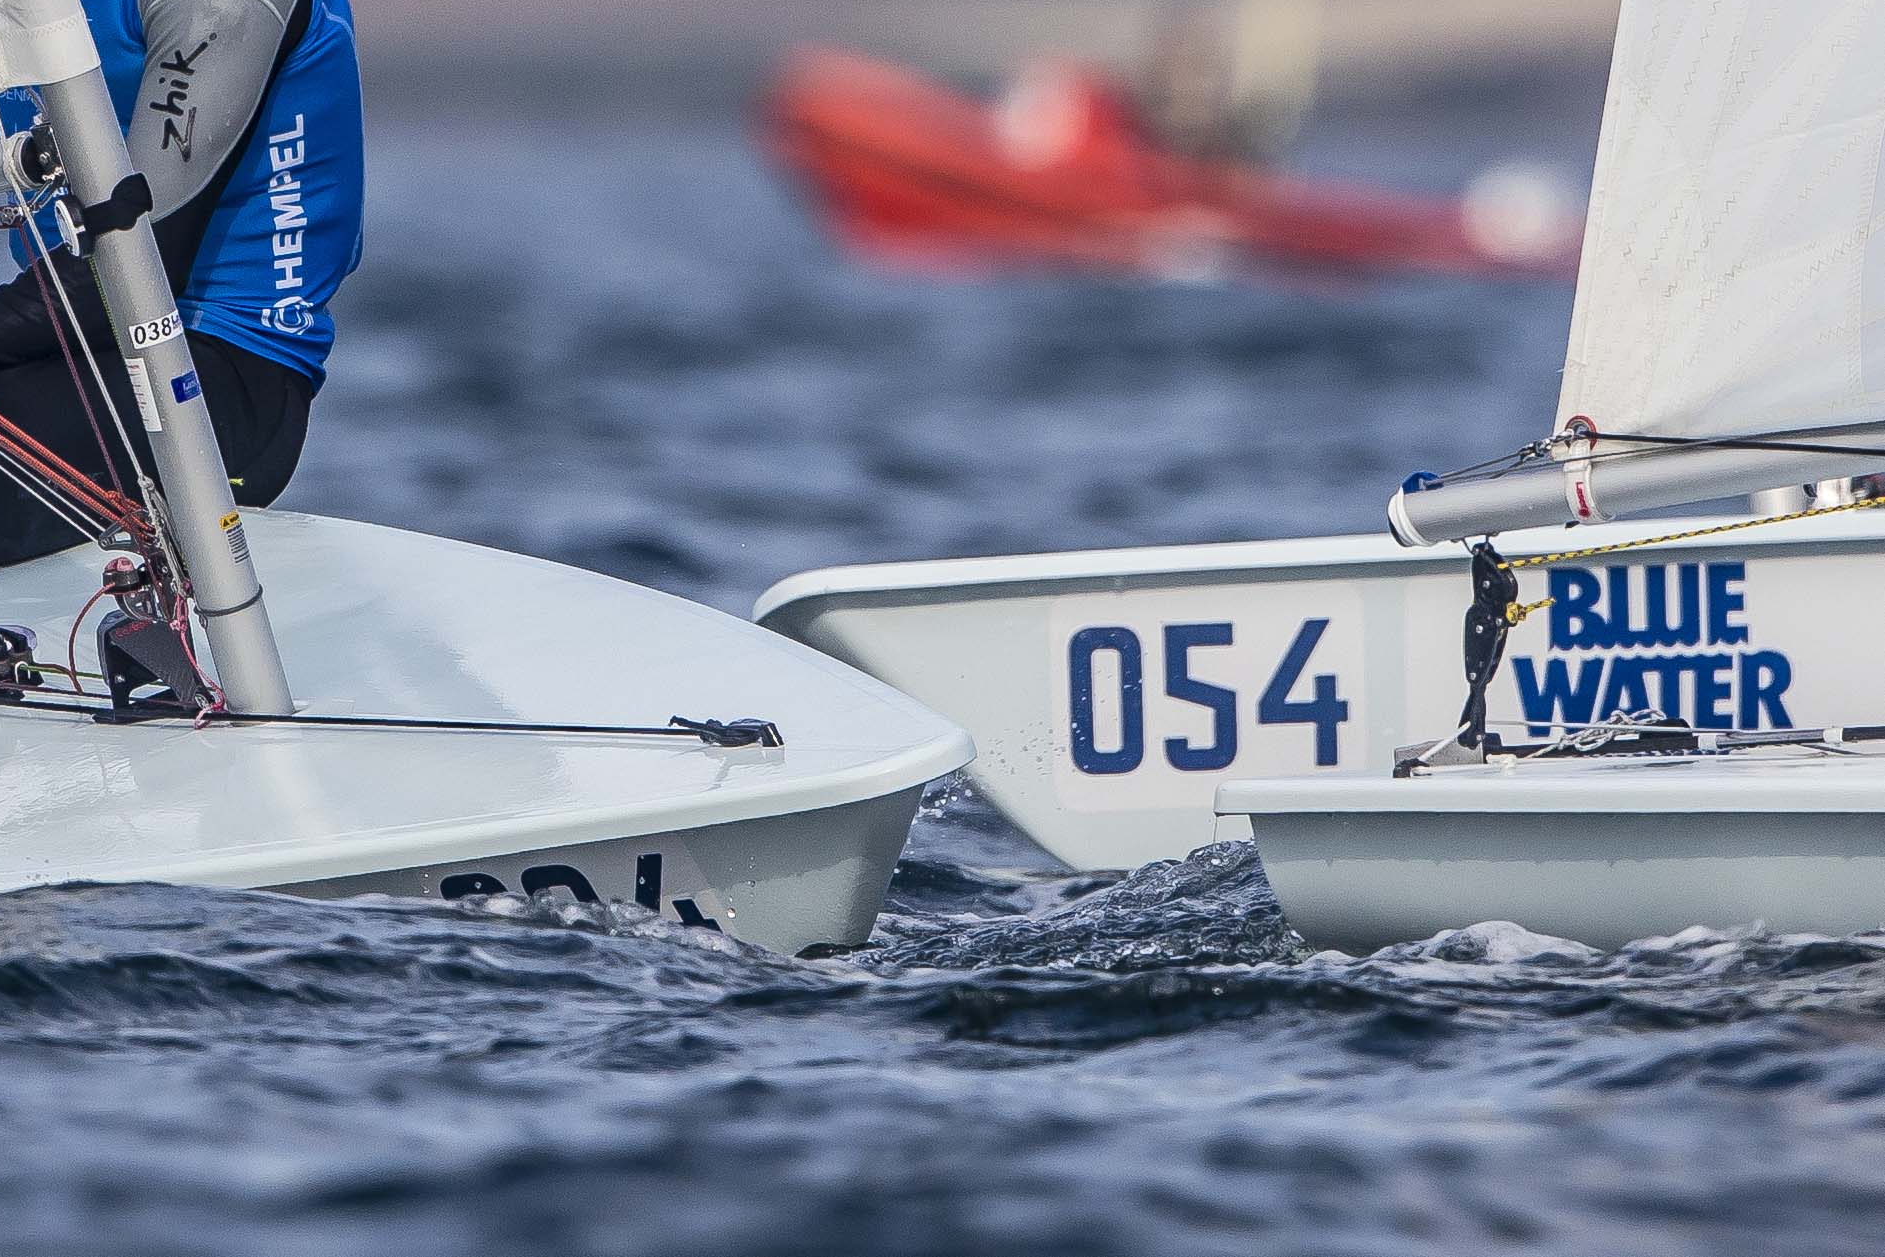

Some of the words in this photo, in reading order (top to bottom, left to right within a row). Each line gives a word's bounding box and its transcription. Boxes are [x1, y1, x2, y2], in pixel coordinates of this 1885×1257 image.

[268, 113, 308, 290] HEMPEL
[1548, 561, 1749, 650] BLUE
[1069, 617, 1349, 775] 054
[1510, 650, 1793, 737] WATER
